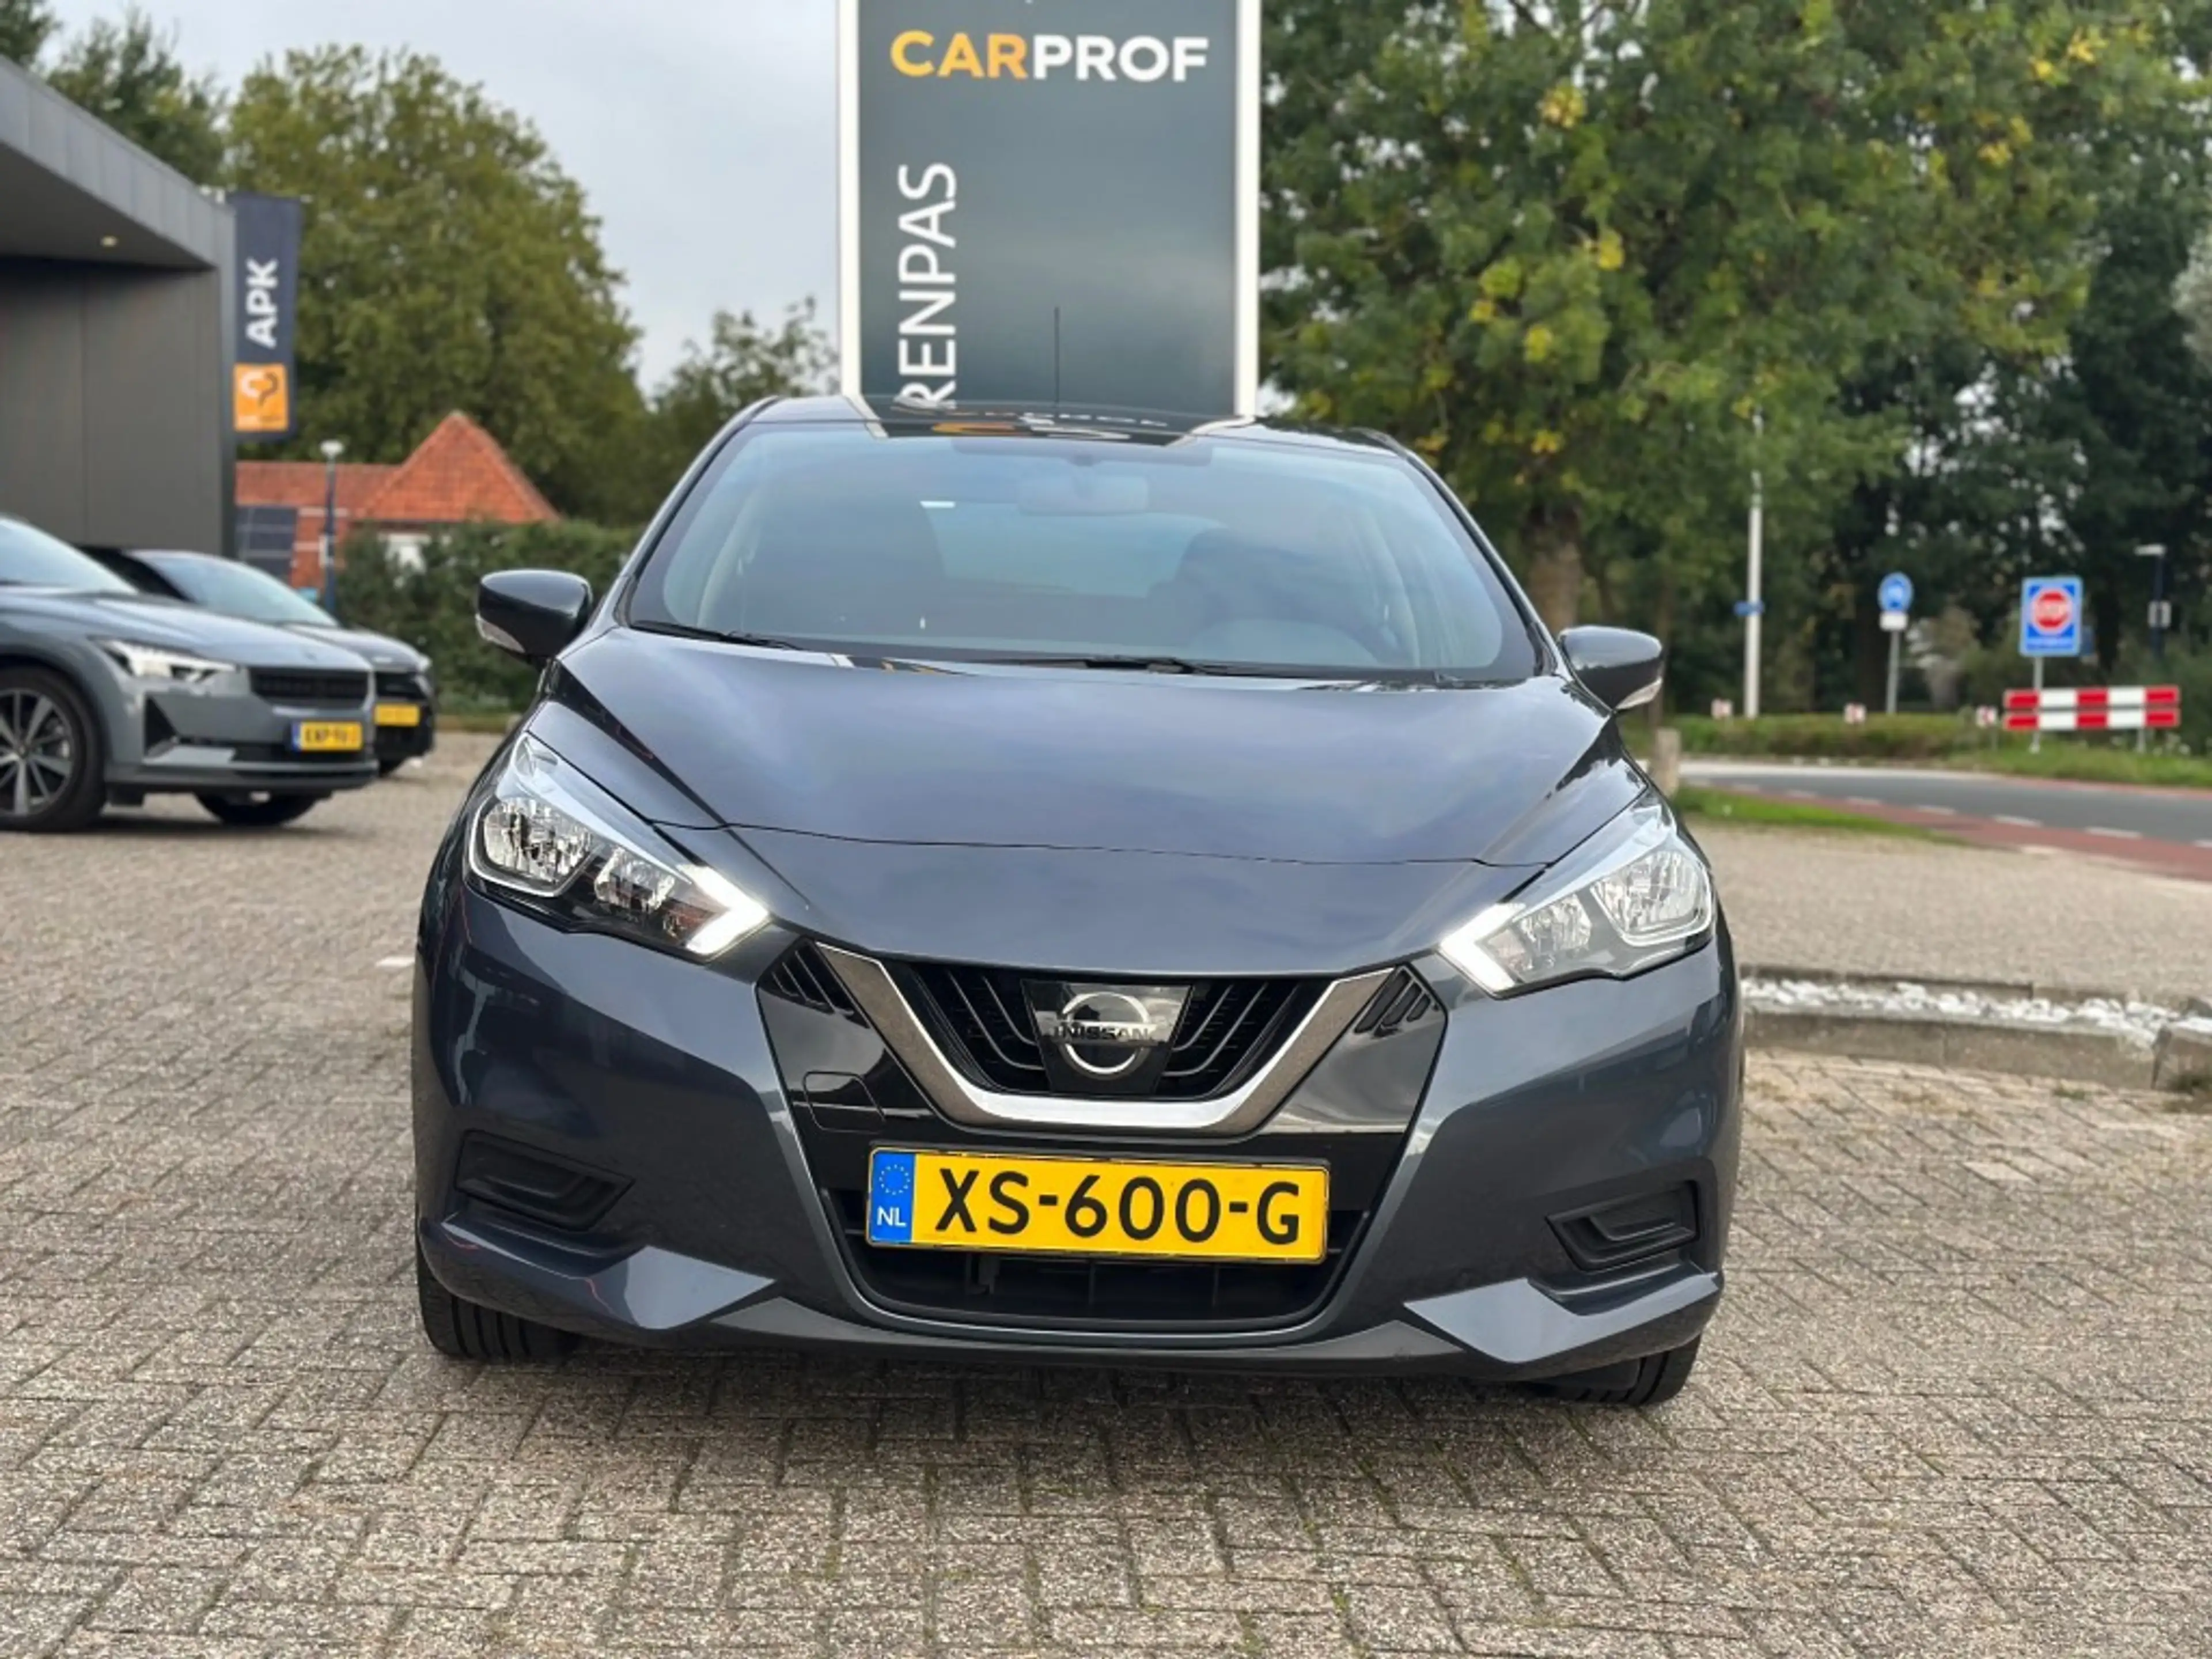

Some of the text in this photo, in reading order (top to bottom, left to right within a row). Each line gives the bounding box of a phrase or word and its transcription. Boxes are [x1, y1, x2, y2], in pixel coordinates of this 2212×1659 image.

[890, 30, 1209, 82] CARPROF
[245, 257, 279, 349] APK
[1061, 1023, 1150, 1040] NISSAN
[876, 1205, 907, 1228] NL
[935, 1168, 1300, 1246] XS-600-G
